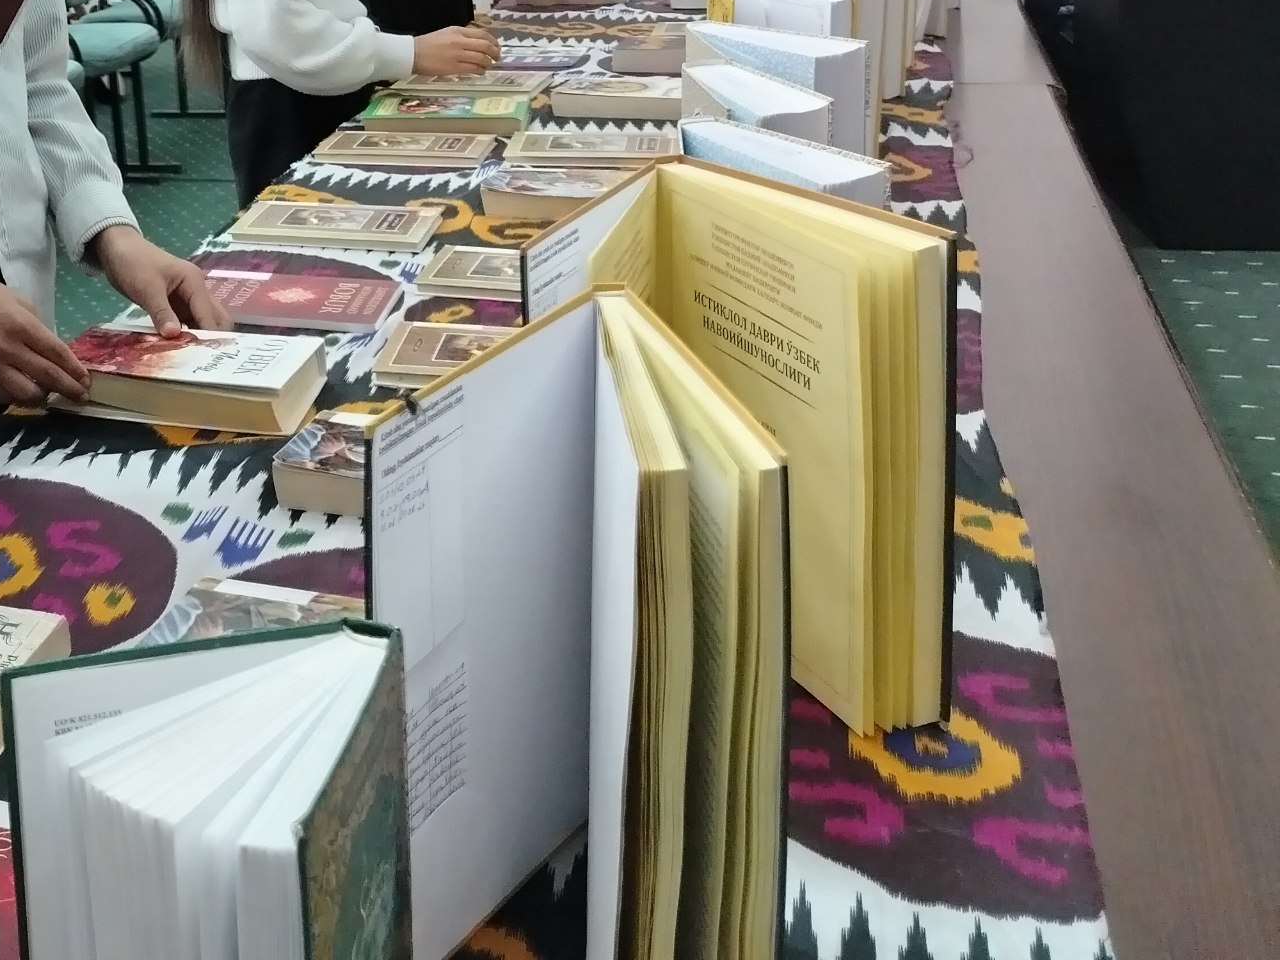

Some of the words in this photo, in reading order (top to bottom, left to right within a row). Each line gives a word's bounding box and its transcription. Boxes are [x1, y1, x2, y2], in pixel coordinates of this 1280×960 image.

[319, 282, 360, 313] BOBUR
[232, 339, 289, 375] OYBEK
[693, 289, 748, 331] ИСТИҚЛОЛ
[750, 322, 784, 352] ДАВРИ
[786, 340, 821, 374] ЎЗБЕК
[703, 315, 811, 391] НАВОИЙШУНОСЛИГИ
